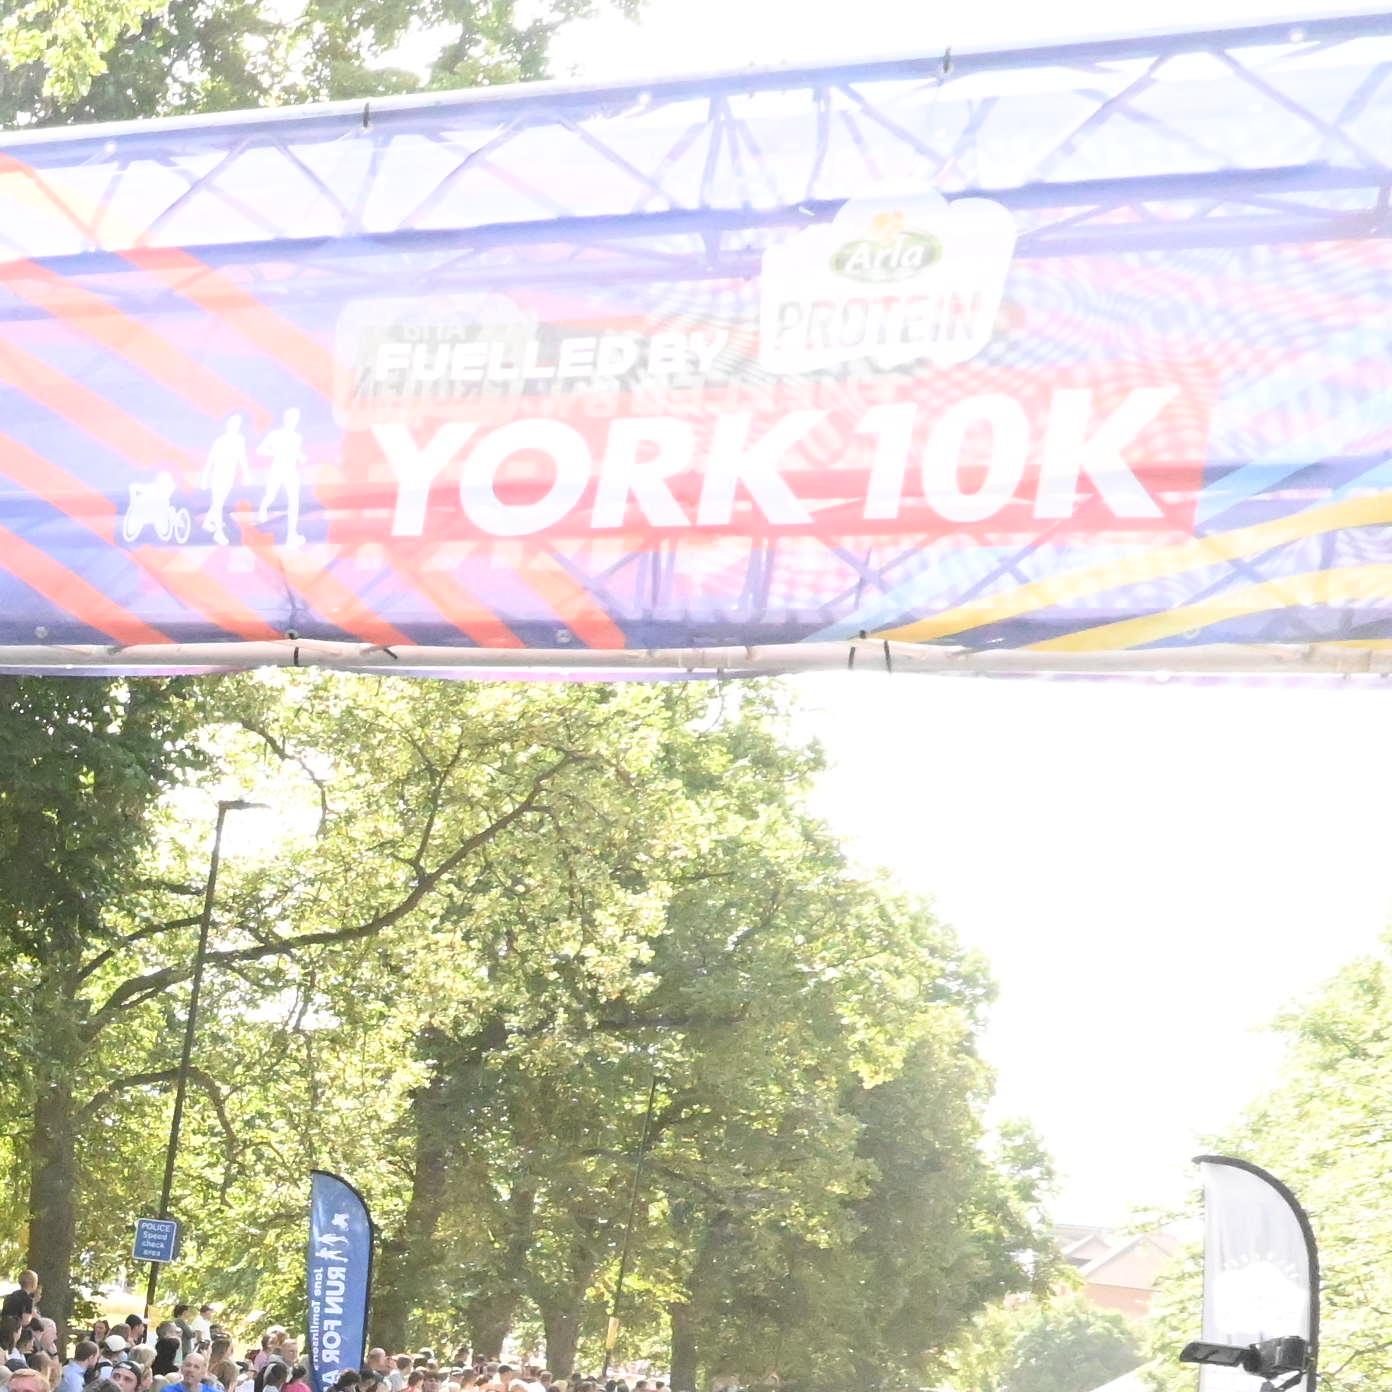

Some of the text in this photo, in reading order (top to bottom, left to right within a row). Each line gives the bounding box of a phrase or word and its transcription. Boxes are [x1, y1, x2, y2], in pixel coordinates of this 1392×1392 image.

[844, 239, 927, 276] Arla
[376, 333, 640, 383] FUELLED
[369, 389, 1175, 540] YORK 10K
